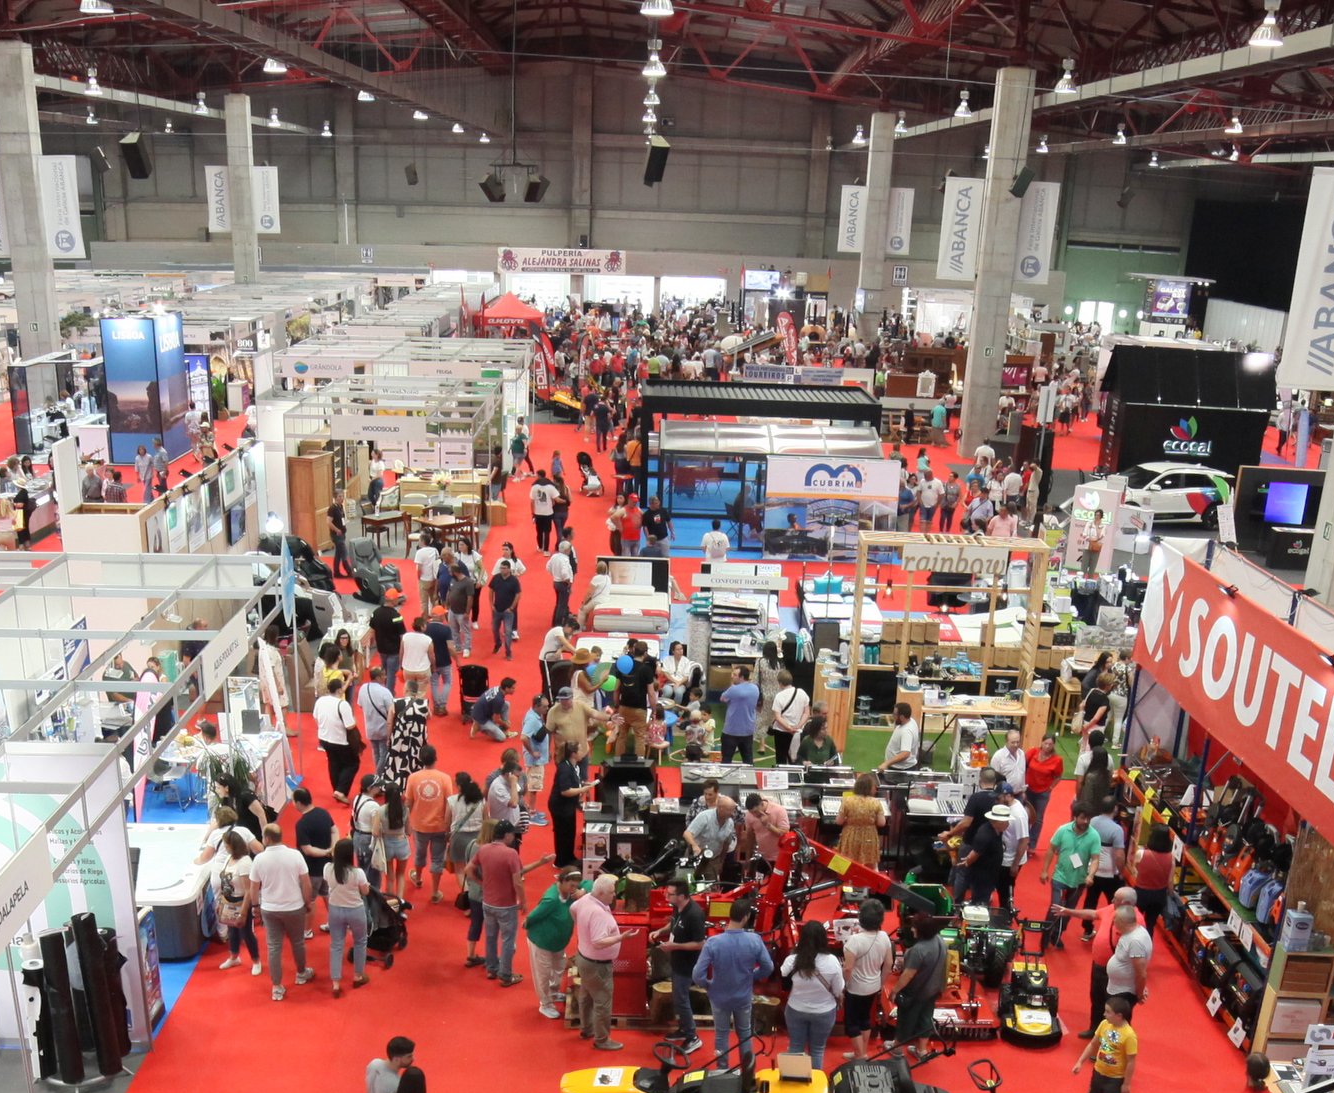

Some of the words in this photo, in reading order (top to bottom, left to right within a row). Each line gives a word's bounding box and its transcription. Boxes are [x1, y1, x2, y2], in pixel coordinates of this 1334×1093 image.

[214, 170, 224, 223] ABANCA
[847, 190, 859, 243] ABANCA
[952, 186, 973, 266] ABANCA
[522, 257, 567, 267] ALEJANDRA
[569, 258, 602, 267] SALINAS
[237, 340, 254, 348] 800
[904, 548, 1005, 574] rainbow
[711, 578, 743, 587] CONFORT
[744, 578, 770, 587] HOGAR
